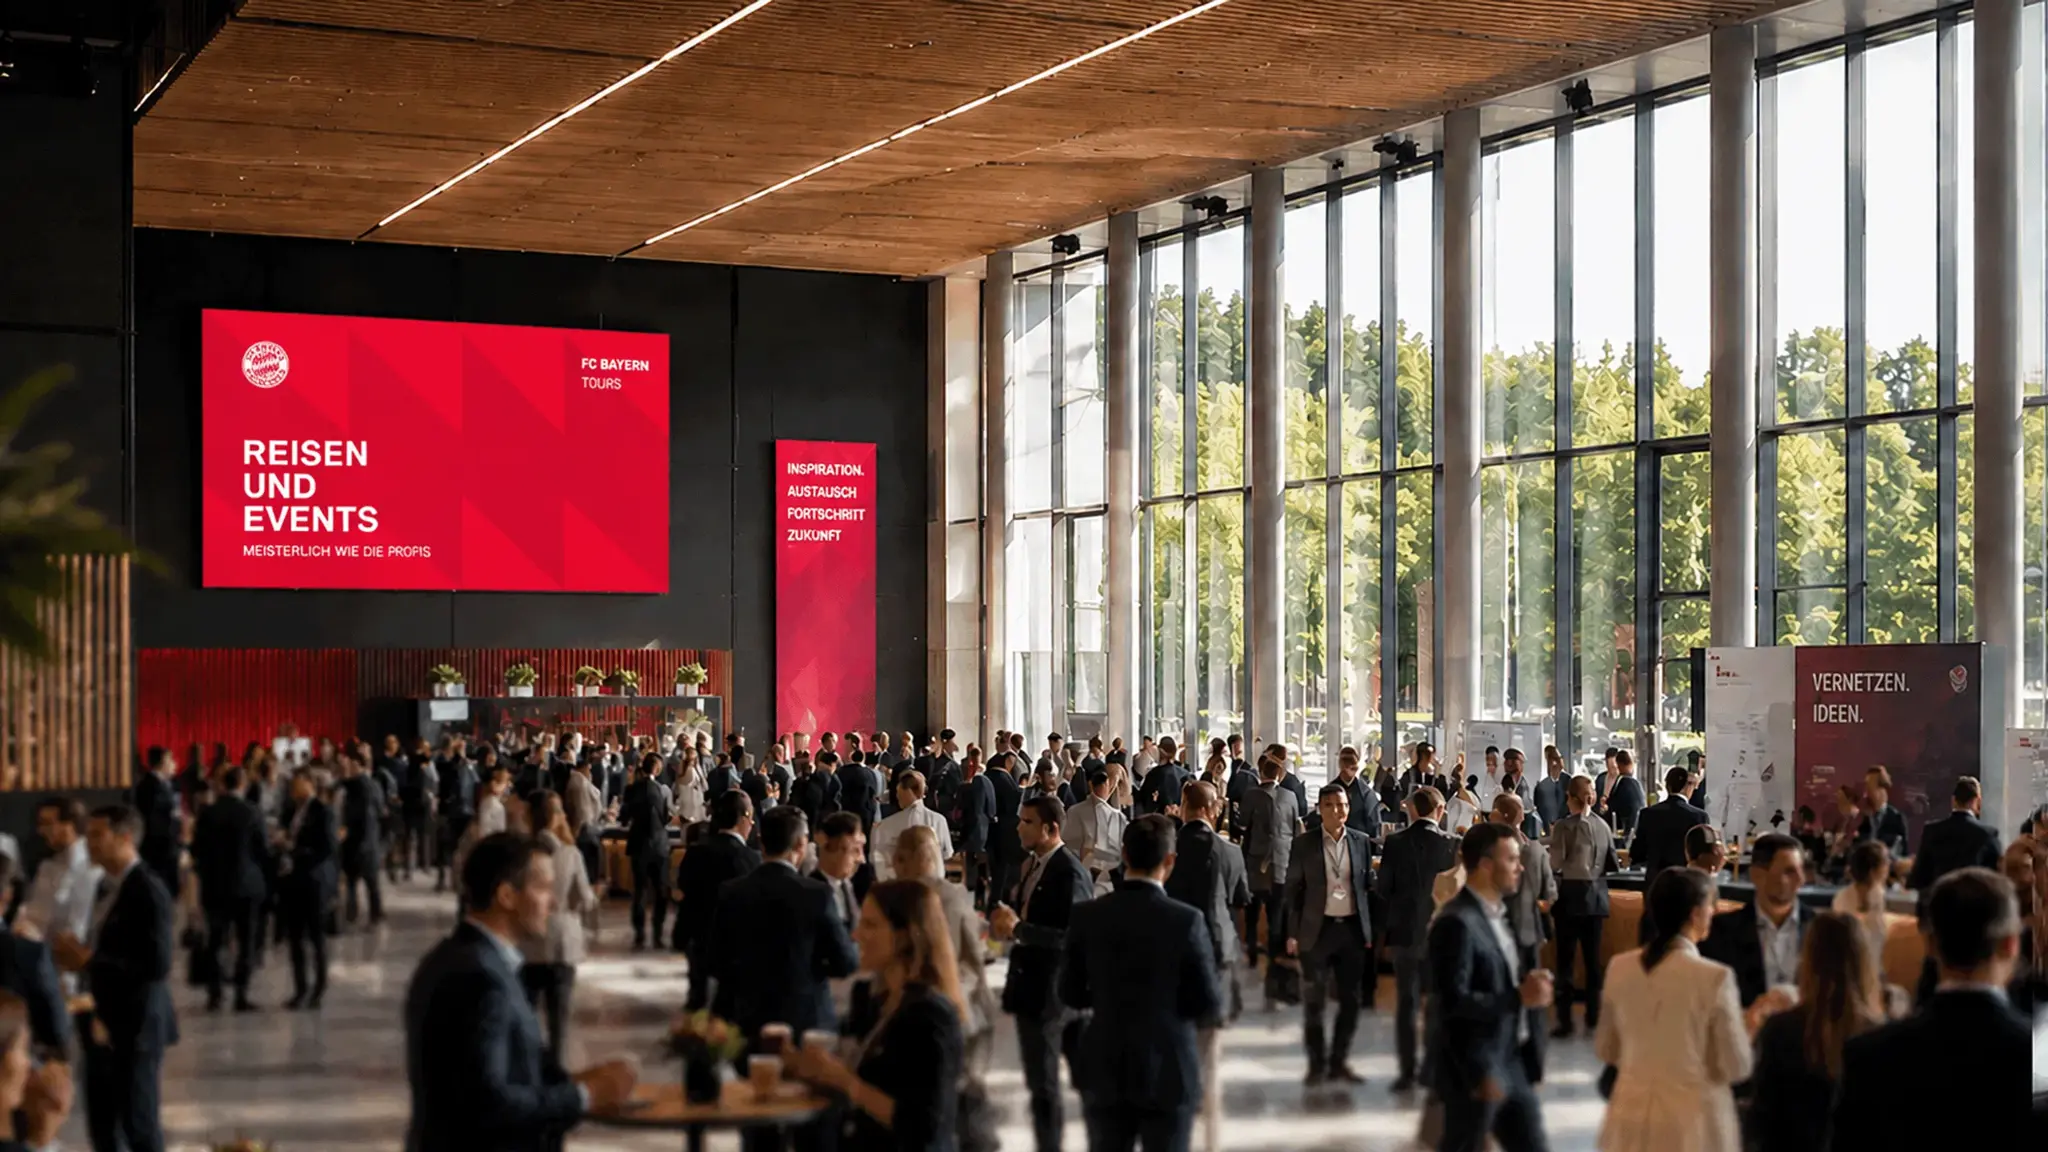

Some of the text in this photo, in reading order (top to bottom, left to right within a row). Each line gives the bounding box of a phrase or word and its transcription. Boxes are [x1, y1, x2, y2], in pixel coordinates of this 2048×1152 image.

[581, 357, 650, 371] FC BAYERN
[581, 376, 622, 390] TOURS
[243, 439, 368, 467] REISEN
[787, 462, 865, 476] INSPIRATION.
[243, 472, 317, 499] UND
[787, 485, 857, 498] AUSTAUSCH
[243, 505, 379, 533] EVENTS
[787, 507, 866, 521] FORTSCHRITT
[787, 528, 842, 541] ZUKUNFT
[243, 544, 432, 558] MEISTERLICH WIE DIE PROFIS
[1812, 672, 1911, 692] VERNETZEN.
[1813, 704, 1864, 723] IDEEN.
